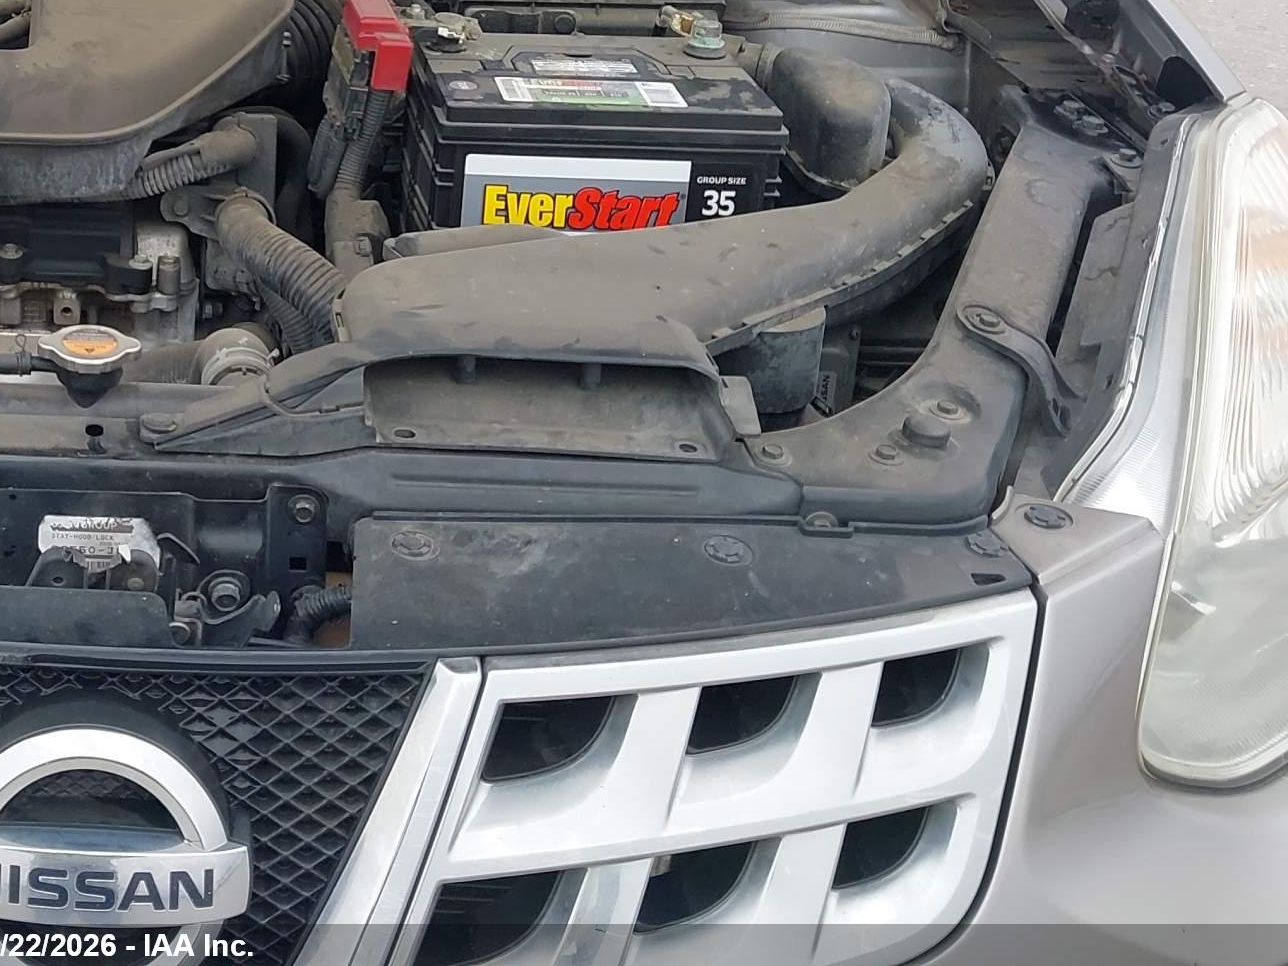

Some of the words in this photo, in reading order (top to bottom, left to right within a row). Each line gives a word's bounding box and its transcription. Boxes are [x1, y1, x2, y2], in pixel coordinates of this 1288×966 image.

[696, 175, 727, 185] GROUP
[727, 176, 747, 185] SIZE
[481, 183, 681, 231] EverStart
[701, 189, 737, 216] 35
